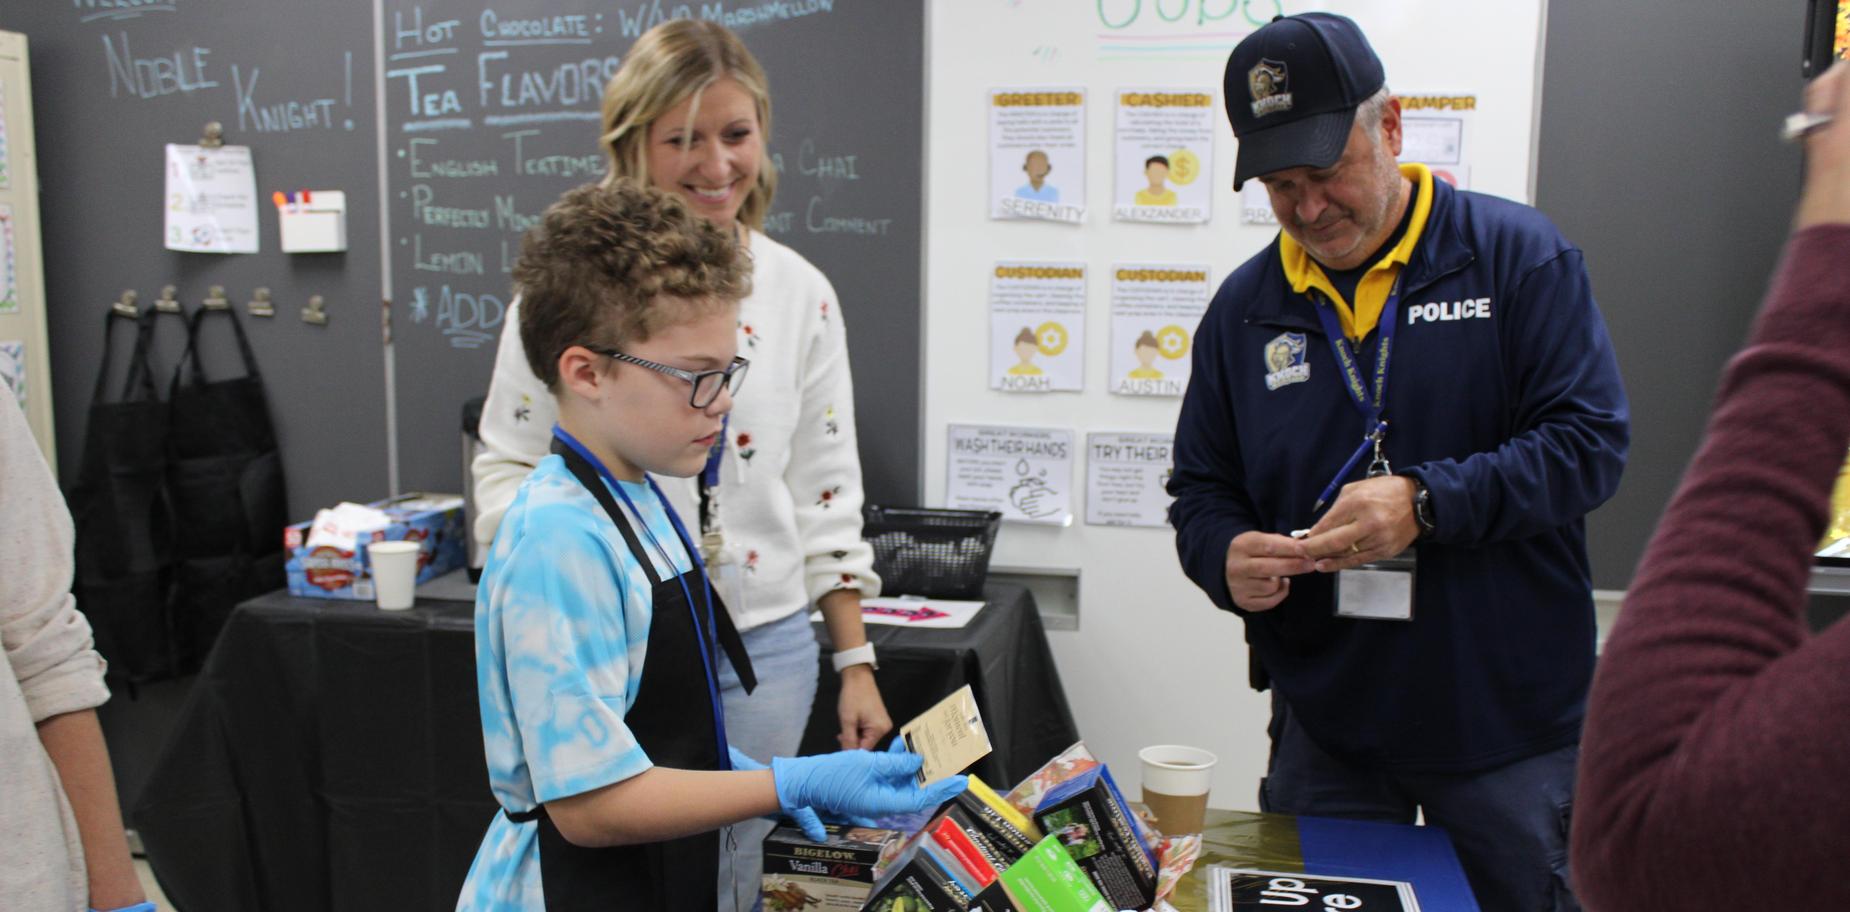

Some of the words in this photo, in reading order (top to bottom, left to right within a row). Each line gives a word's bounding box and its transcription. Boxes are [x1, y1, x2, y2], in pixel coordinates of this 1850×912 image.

[387, 64, 462, 115] TEA
[1000, 92, 1079, 107] GREETER
[1127, 92, 1206, 107] CASHIER
[1399, 96, 1475, 111] TAMPER
[1001, 197, 1085, 221] SERENITY
[995, 266, 1083, 281] CUSTODIAN
[1116, 269, 1206, 283] CUSTODIAN
[1408, 298, 1491, 325] POLICE
[1002, 376, 1050, 390] NOAH
[1119, 380, 1182, 395] AUSTIN
[1094, 445, 1123, 460] TRY
[1125, 446, 1168, 461] THEIR
[793, 847, 856, 860] BIGELOW
[788, 860, 828, 874] Vanilla
